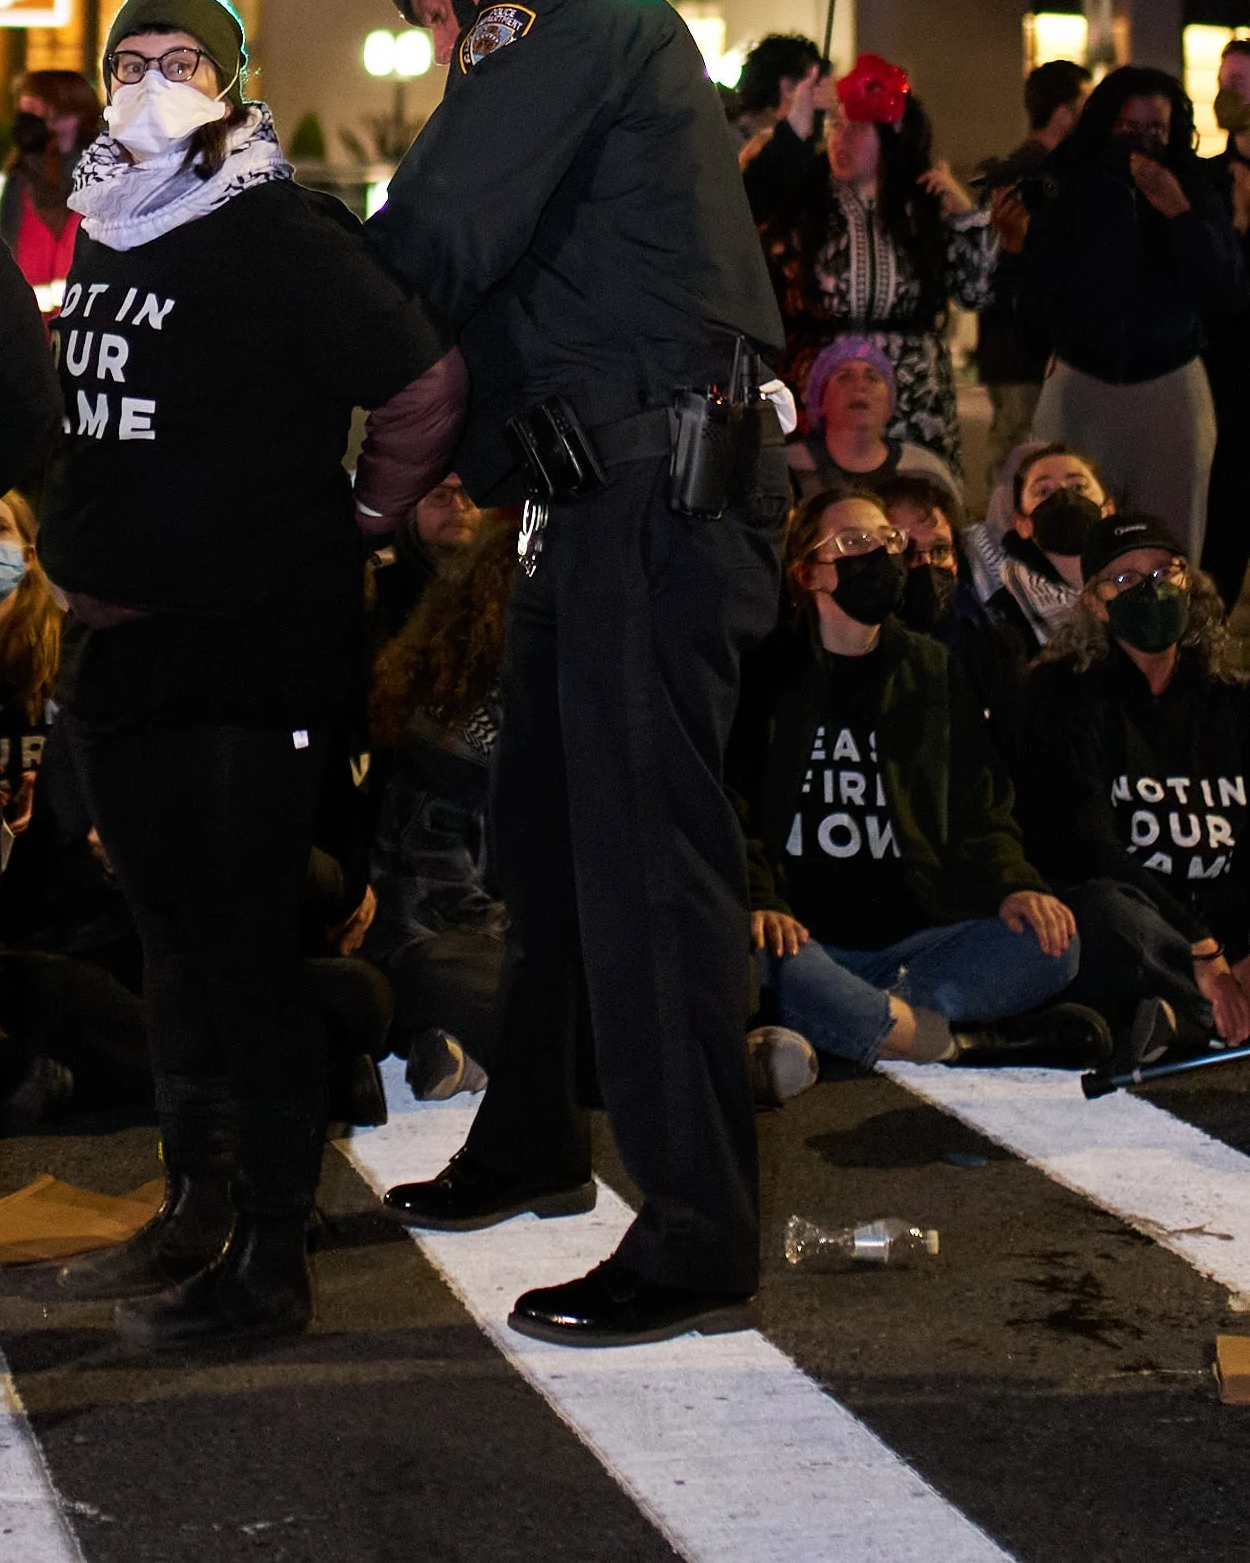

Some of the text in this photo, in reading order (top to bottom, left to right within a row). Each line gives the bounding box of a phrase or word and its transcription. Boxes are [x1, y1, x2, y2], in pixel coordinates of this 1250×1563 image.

[59, 282, 177, 332] OT IN
[61, 389, 157, 441] ME
[1110, 773, 1248, 809] NOT IN
[1130, 808, 1237, 850] OUR
